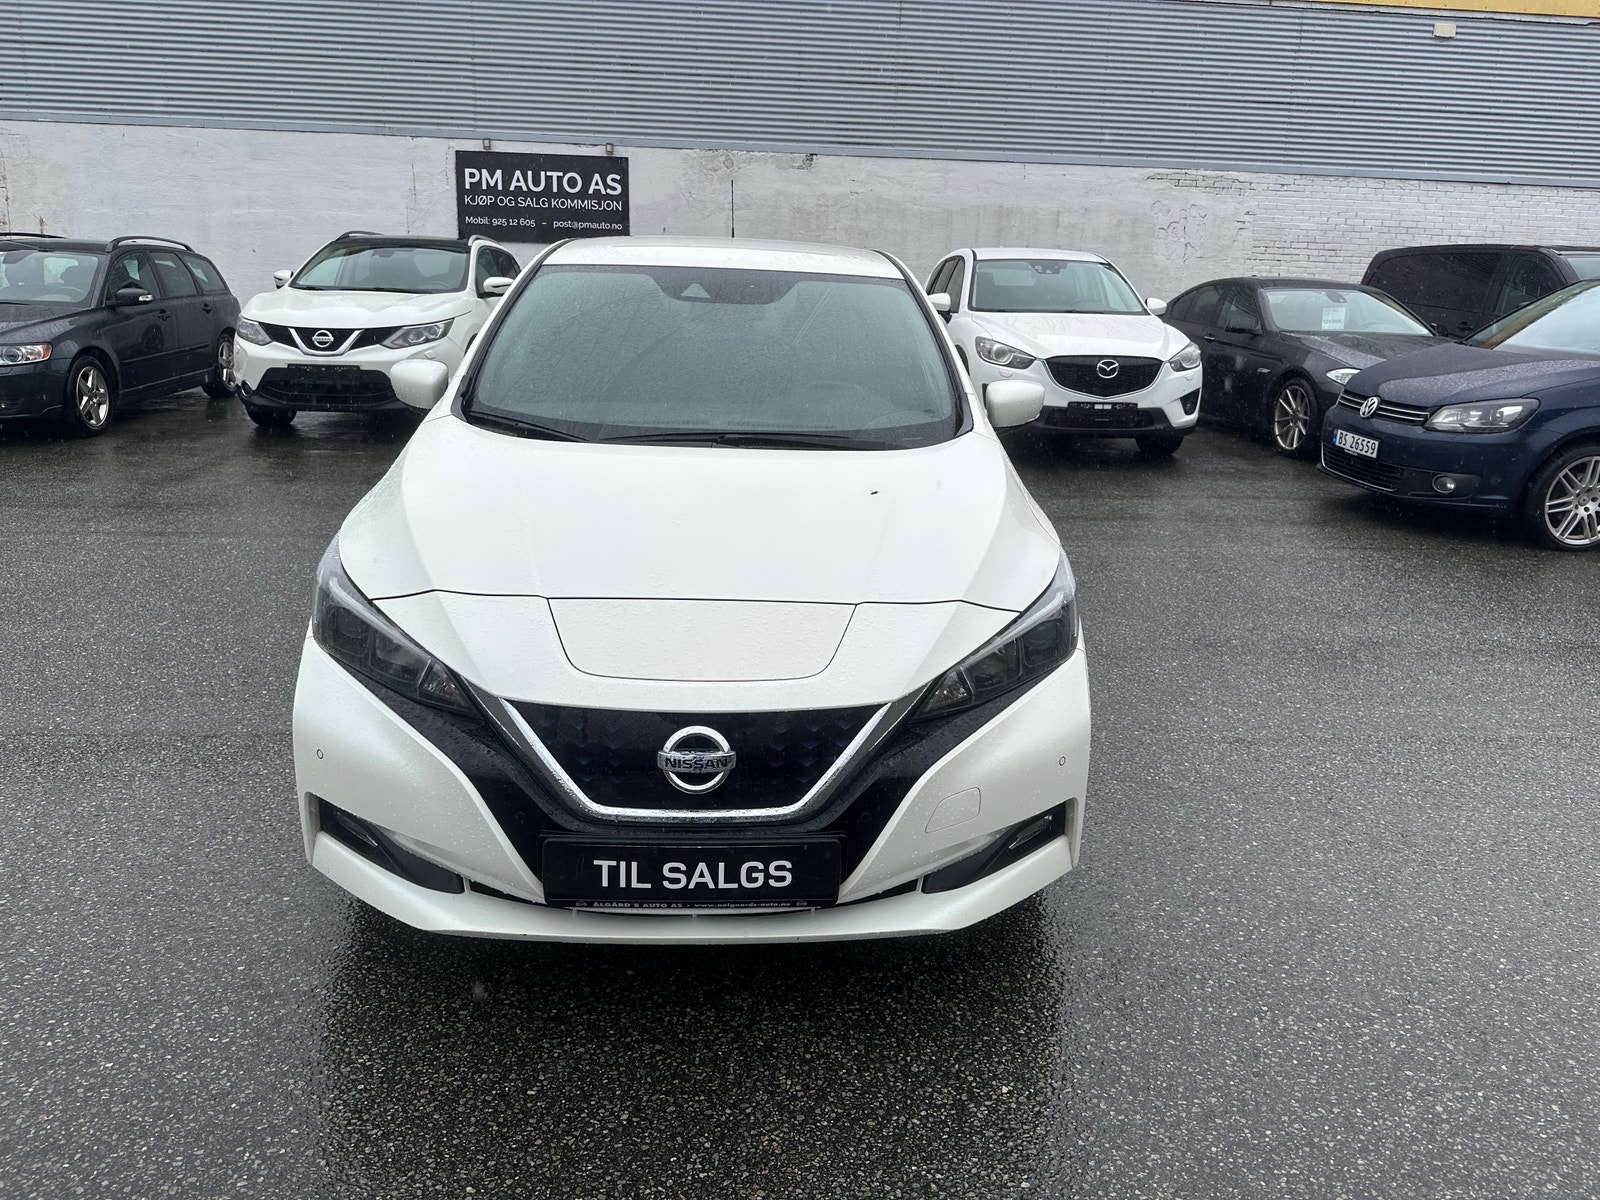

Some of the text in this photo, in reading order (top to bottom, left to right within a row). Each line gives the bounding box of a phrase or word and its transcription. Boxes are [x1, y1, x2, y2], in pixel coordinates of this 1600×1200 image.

[464, 168, 622, 195] PM AUTO AS
[464, 195, 622, 211] KJØP OG SALG KOMMISJON
[465, 216, 491, 225] Mobil:
[492, 218, 507, 226] 925
[508, 218, 518, 226] 12
[519, 218, 536, 227] 605
[553, 220, 623, 230] post@pmauto.no
[1338, 432, 1348, 446] BS
[1350, 436, 1376, 455] 26559
[665, 757, 728, 769] NISSAN
[593, 859, 793, 889] TIL SALGS
